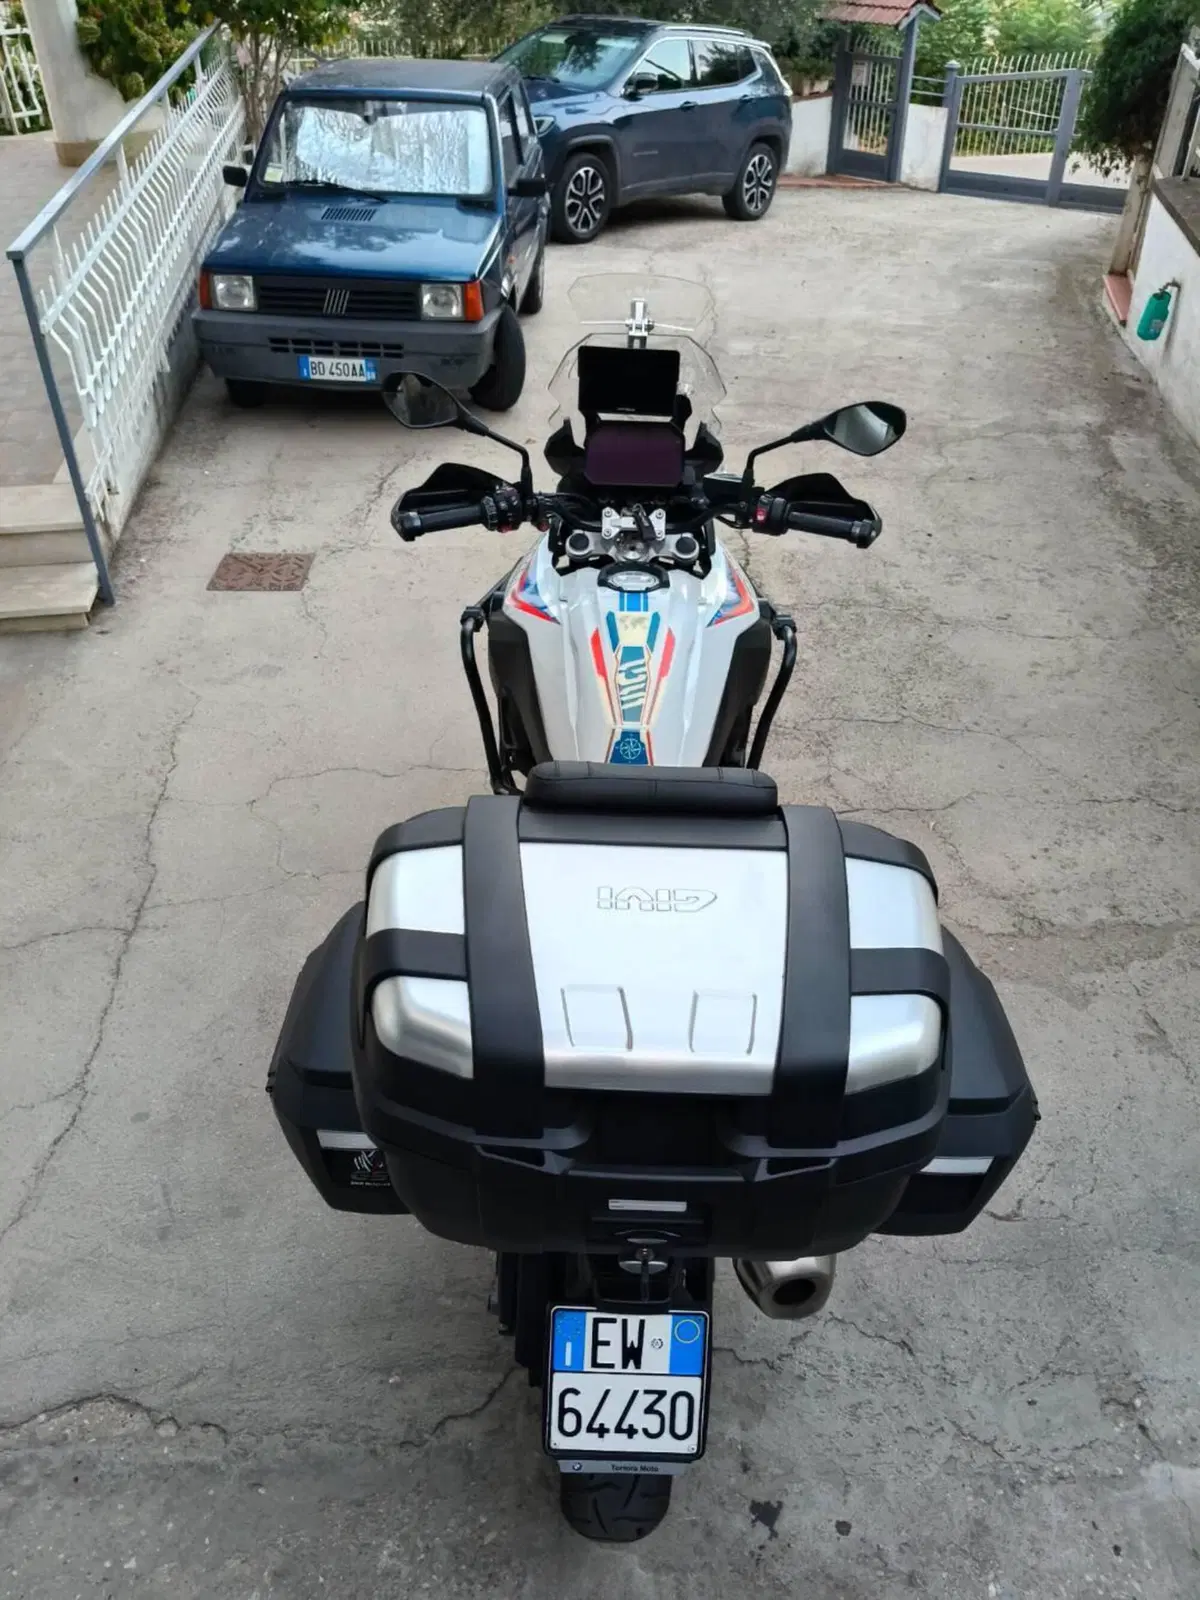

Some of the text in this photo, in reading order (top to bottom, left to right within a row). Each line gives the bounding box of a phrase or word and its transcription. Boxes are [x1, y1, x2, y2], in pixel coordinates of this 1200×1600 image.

[310, 361, 326, 376] BD
[329, 362, 366, 378] 450AA
[597, 886, 718, 913] GIVI
[590, 1317, 646, 1370] EW
[557, 1387, 695, 1441] 64430
